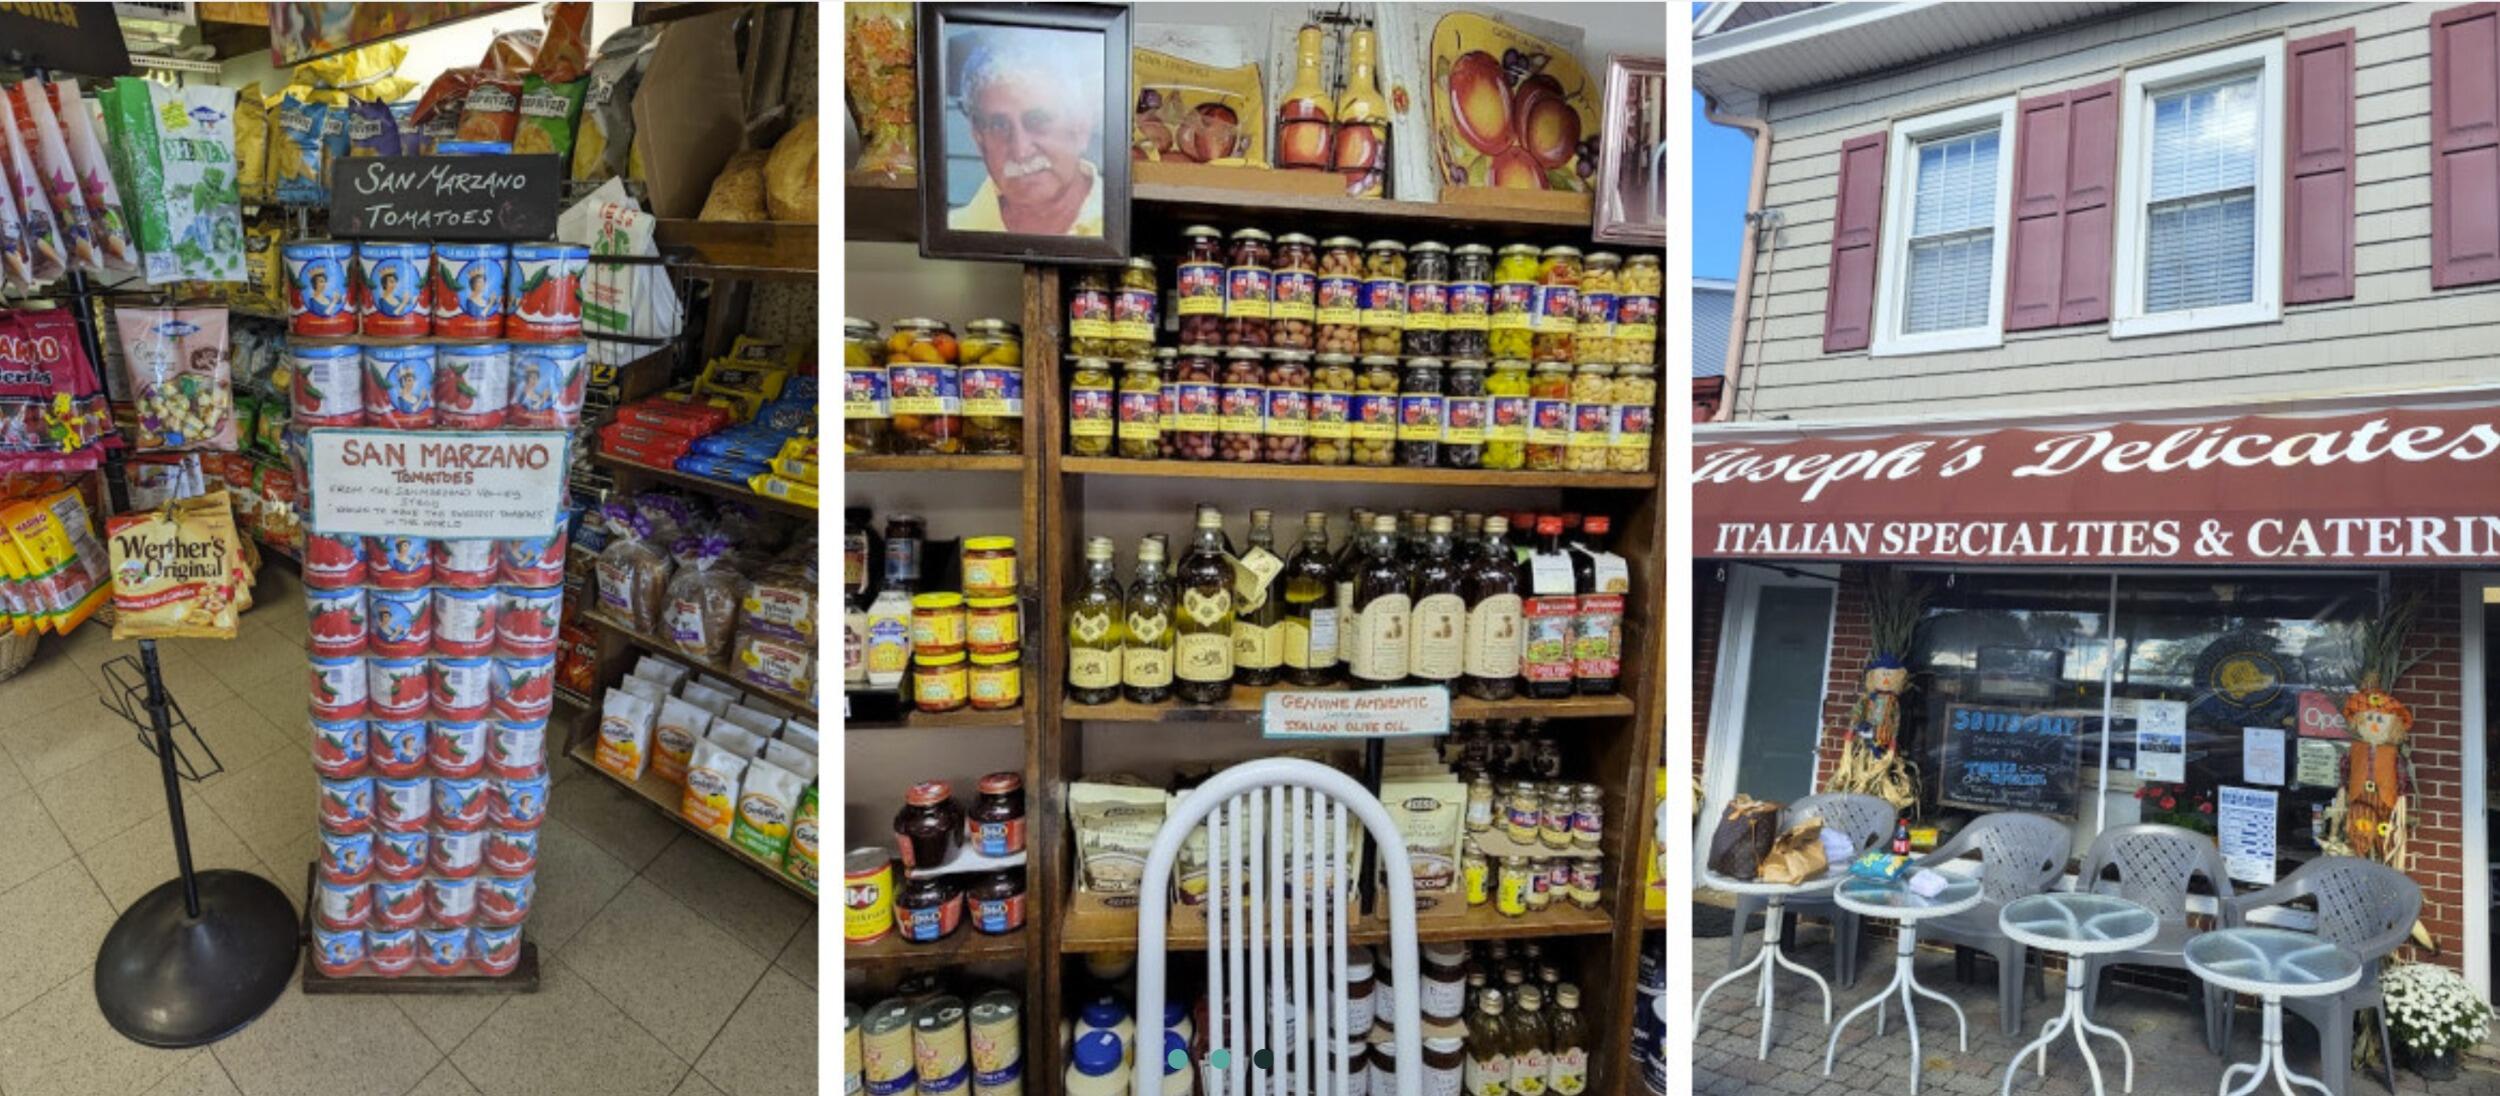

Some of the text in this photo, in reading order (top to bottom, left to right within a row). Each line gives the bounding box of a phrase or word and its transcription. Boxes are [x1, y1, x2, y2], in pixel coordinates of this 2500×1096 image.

[355, 162, 526, 198] SAN MARZANO
[365, 204, 493, 229] TOMATOES
[342, 439, 549, 470] SAN MARZANO
[1692, 417, 2500, 503] Joseph's Delicates
[392, 470, 474, 485] TOMATOES
[114, 535, 226, 560] Werther's
[1713, 521, 1875, 555] ITALIAN
[1879, 519, 2181, 557] SPECIALTIES
[2193, 518, 2234, 557] &
[145, 557, 223, 582] Original
[1282, 695, 1350, 710] GENUINE
[1284, 720, 1338, 732] ITALIAN
[1345, 721, 1381, 732] OLIVE
[2305, 707, 2346, 732] Ope
